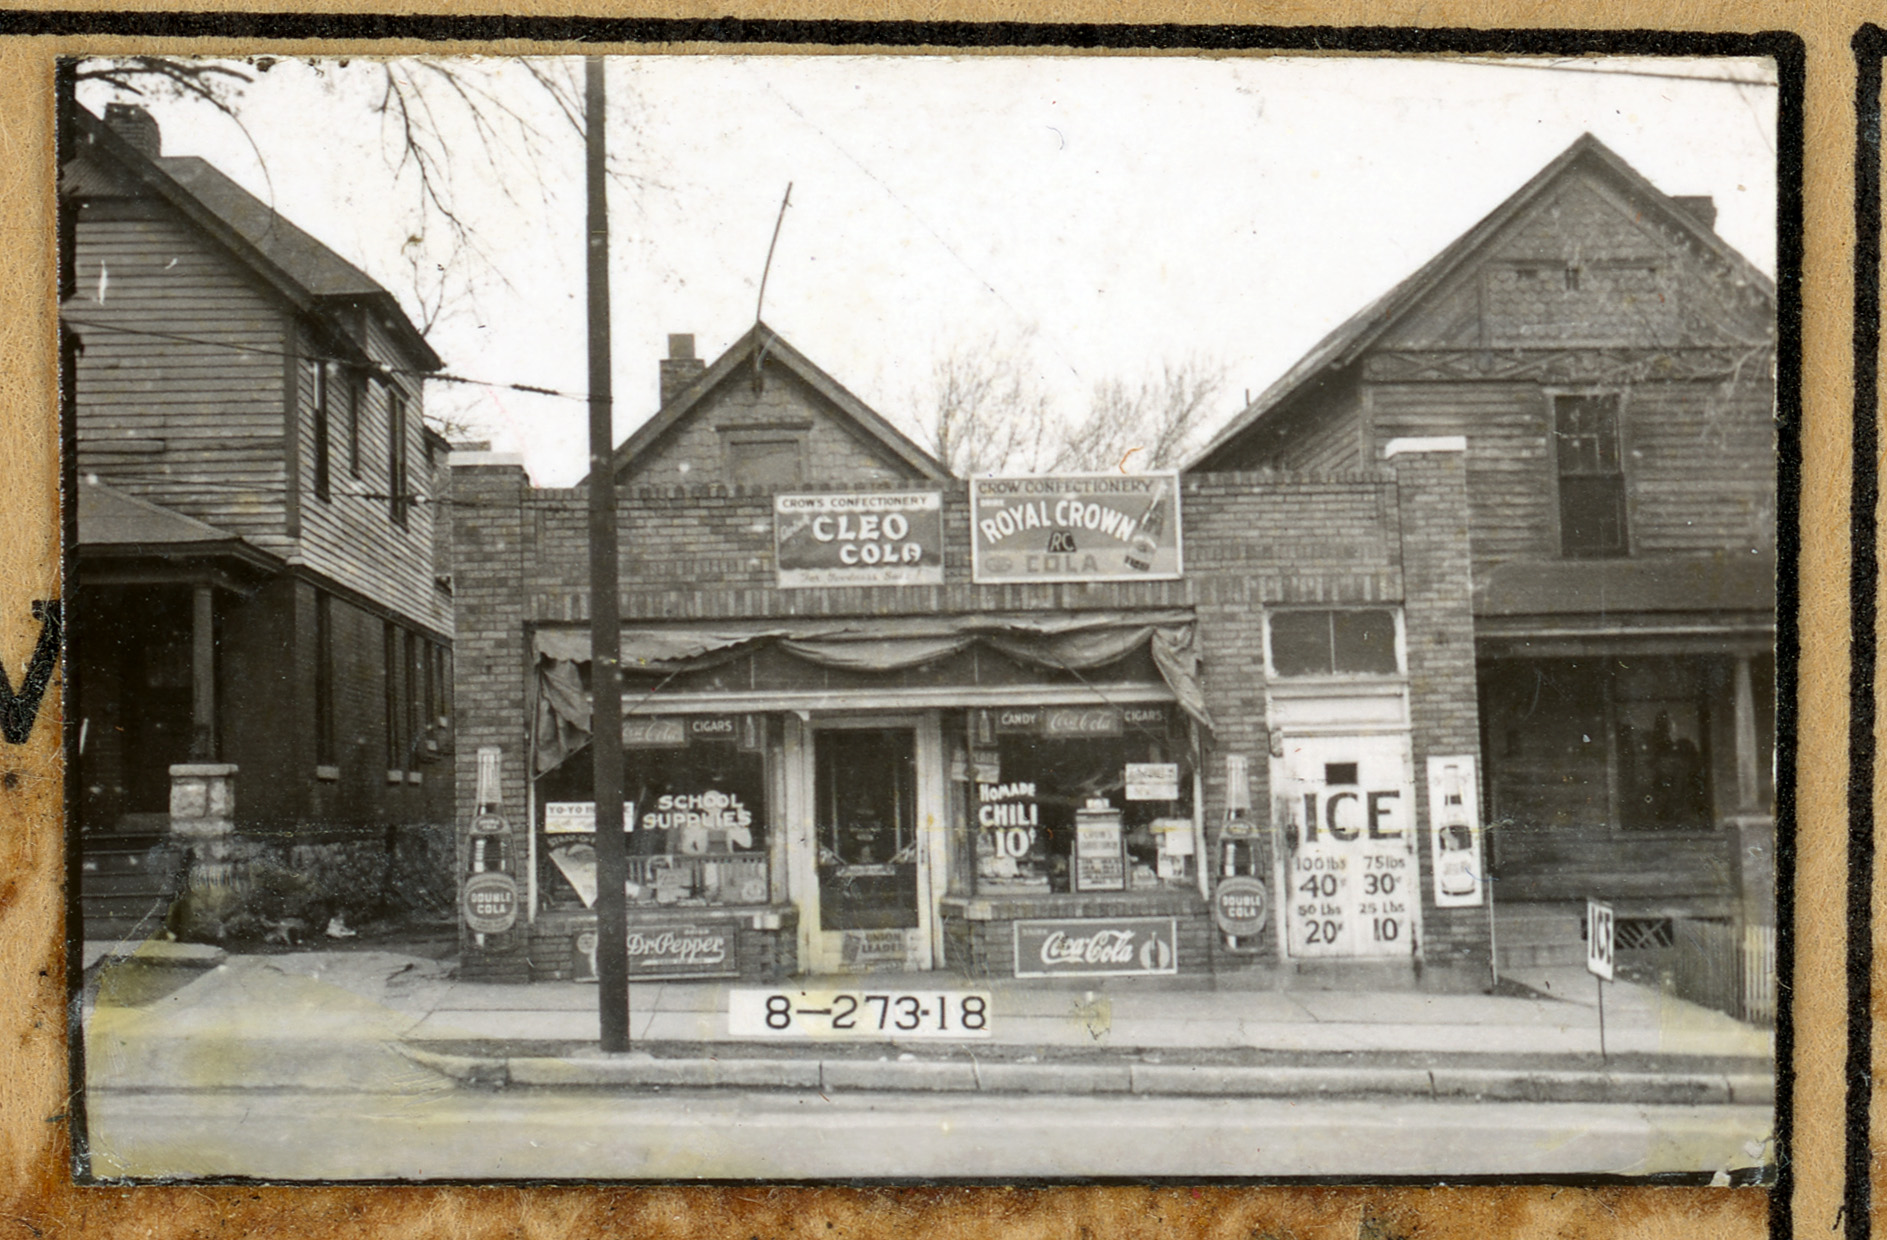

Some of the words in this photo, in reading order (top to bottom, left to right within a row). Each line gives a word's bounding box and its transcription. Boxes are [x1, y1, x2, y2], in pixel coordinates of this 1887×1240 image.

[978, 480, 1020, 494] CROW
[1025, 479, 1151, 494] CONFECTIONERY
[830, 495, 928, 508] CONFECTIONERY
[812, 513, 909, 542] CLEO
[980, 501, 1051, 544] ROYAL
[1055, 500, 1136, 542] CROWN
[839, 542, 922, 565] COLA
[1026, 554, 1099, 573] COLA
[1001, 711, 1037, 725] CANDY
[1124, 710, 1163, 722] CIGARS
[692, 720, 733, 732] CIGARS
[658, 793, 744, 810] SCHOOL
[643, 811, 752, 829] SUPPLIES
[979, 802, 1038, 828] CHILI
[1303, 790, 1403, 842] ICE
[476, 904, 507, 914] COLA
[1222, 895, 1261, 906] DOUBLE
[1228, 907, 1257, 918] COLA
[1590, 905, 1611, 965] ICE
[1040, 929, 1136, 965] Coca-Cola
